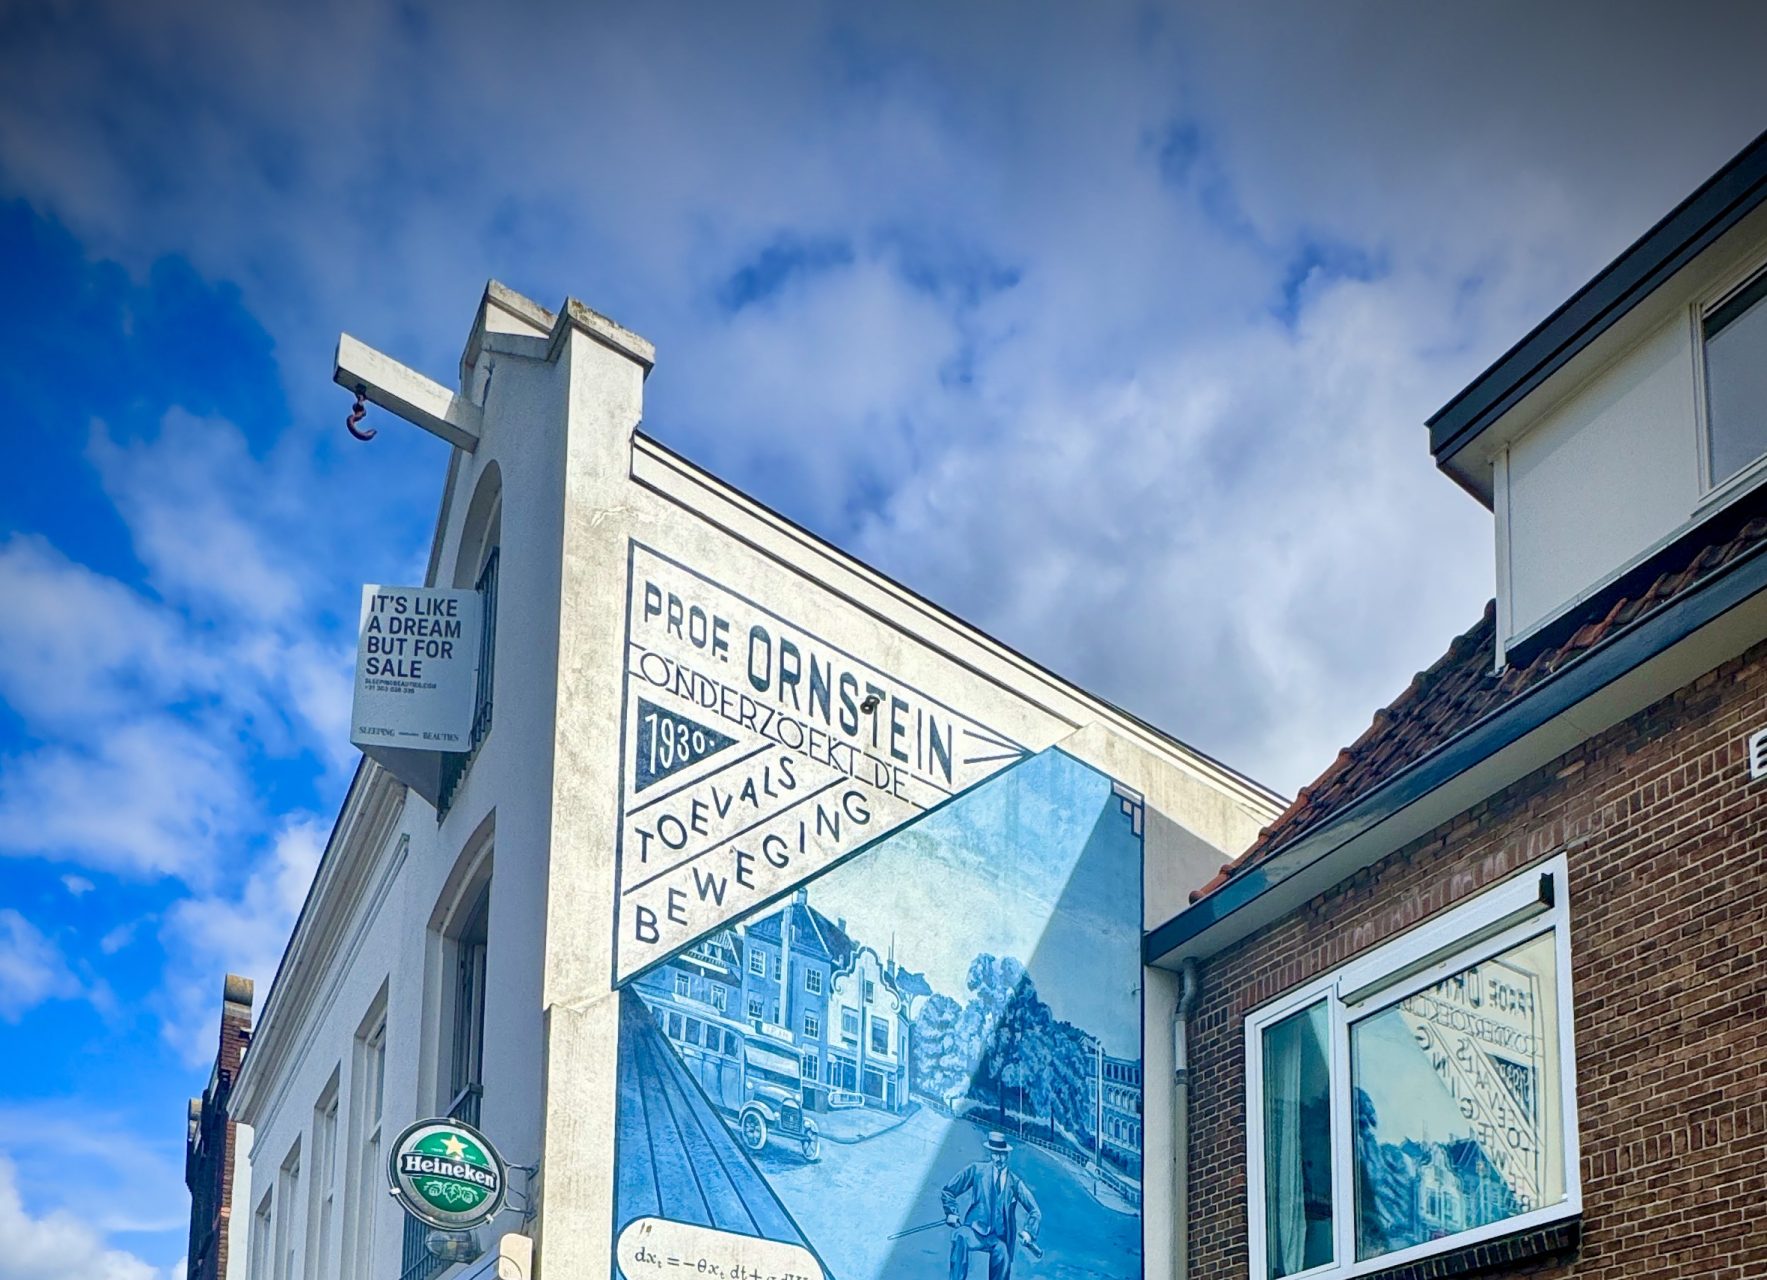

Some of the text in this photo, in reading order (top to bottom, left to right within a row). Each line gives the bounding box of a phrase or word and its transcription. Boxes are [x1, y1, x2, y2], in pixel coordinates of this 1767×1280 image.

[371, 595, 458, 617] IT'S LIKE
[368, 615, 461, 638] A DREAM
[367, 636, 453, 659] BUT FOR
[366, 657, 422, 678] SALE
[747, 624, 953, 785] ORNSTEIN
[640, 652, 910, 804] ONDERZOEKT DE
[635, 757, 796, 863] TOEVALS
[636, 791, 870, 943] BEWEGING
[404, 1155, 495, 1188] Heineken
